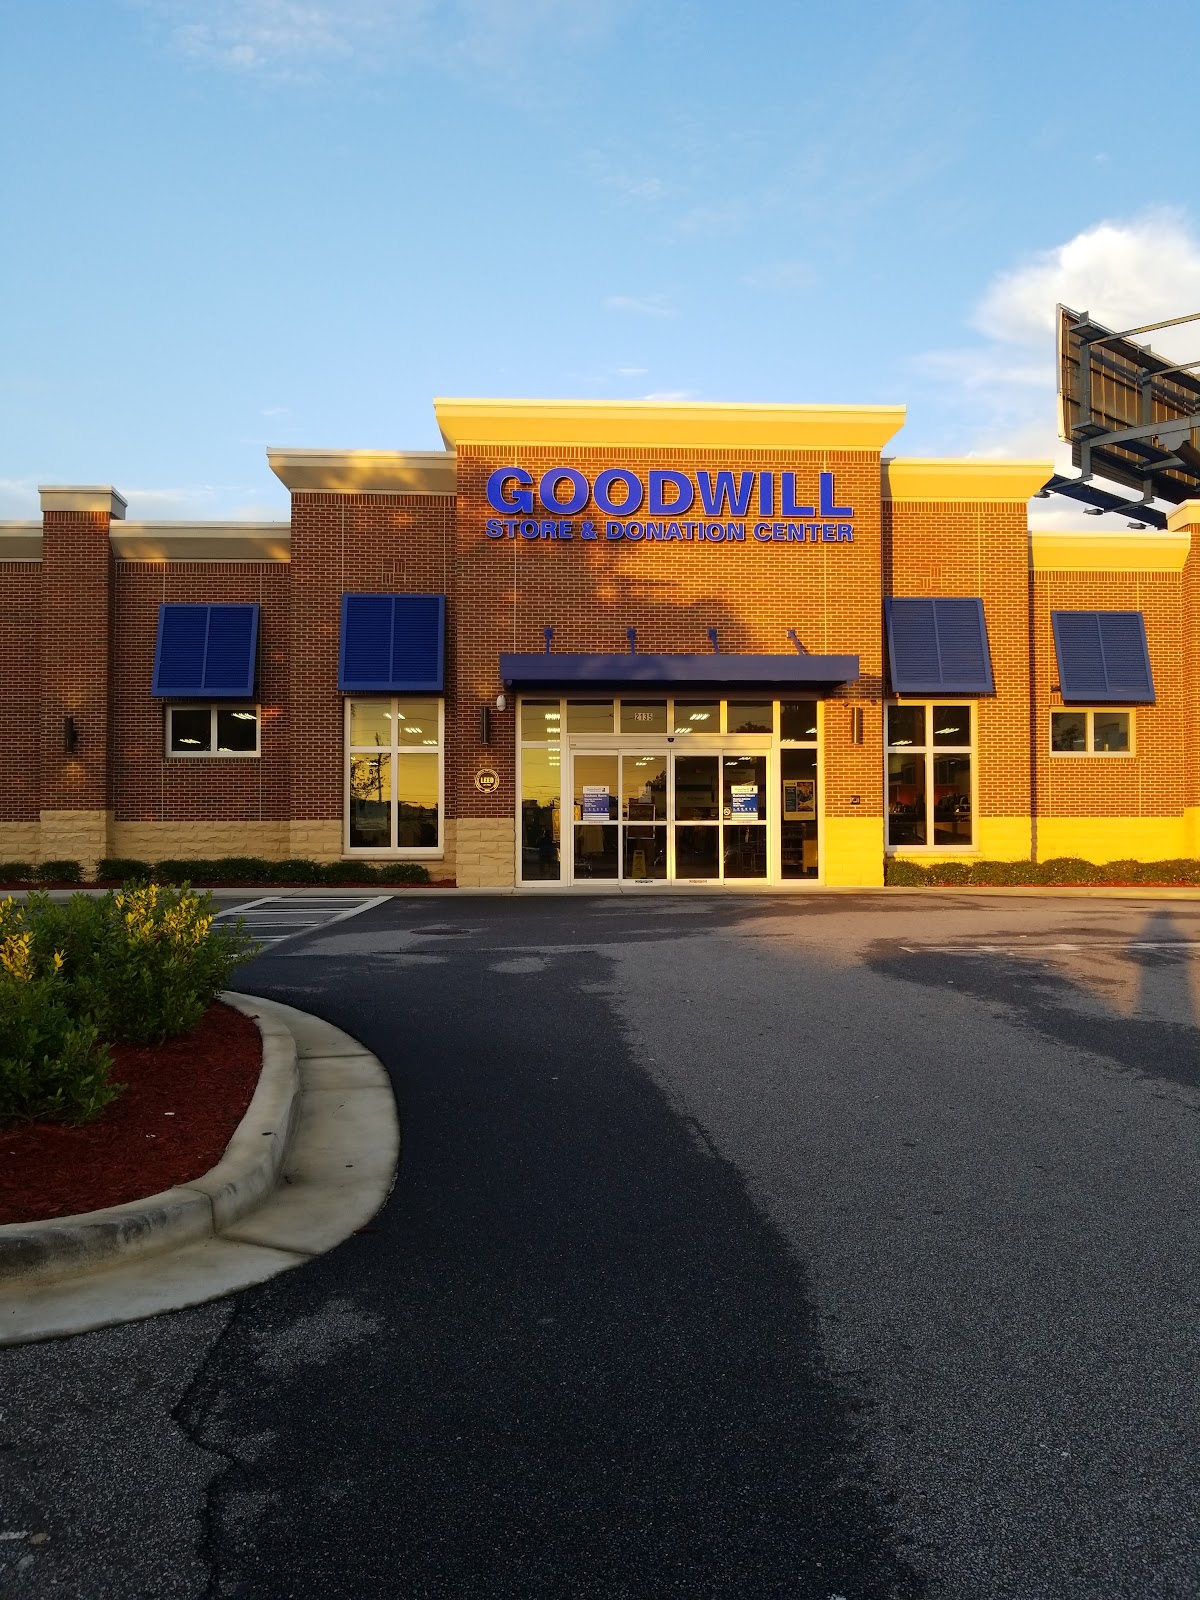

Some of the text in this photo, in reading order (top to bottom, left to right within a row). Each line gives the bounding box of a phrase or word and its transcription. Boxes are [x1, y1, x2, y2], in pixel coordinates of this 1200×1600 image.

[486, 466, 854, 518] GOODWILL
[486, 519, 854, 543] STORE & DONATION CENTER
[635, 712, 653, 721] 2135
